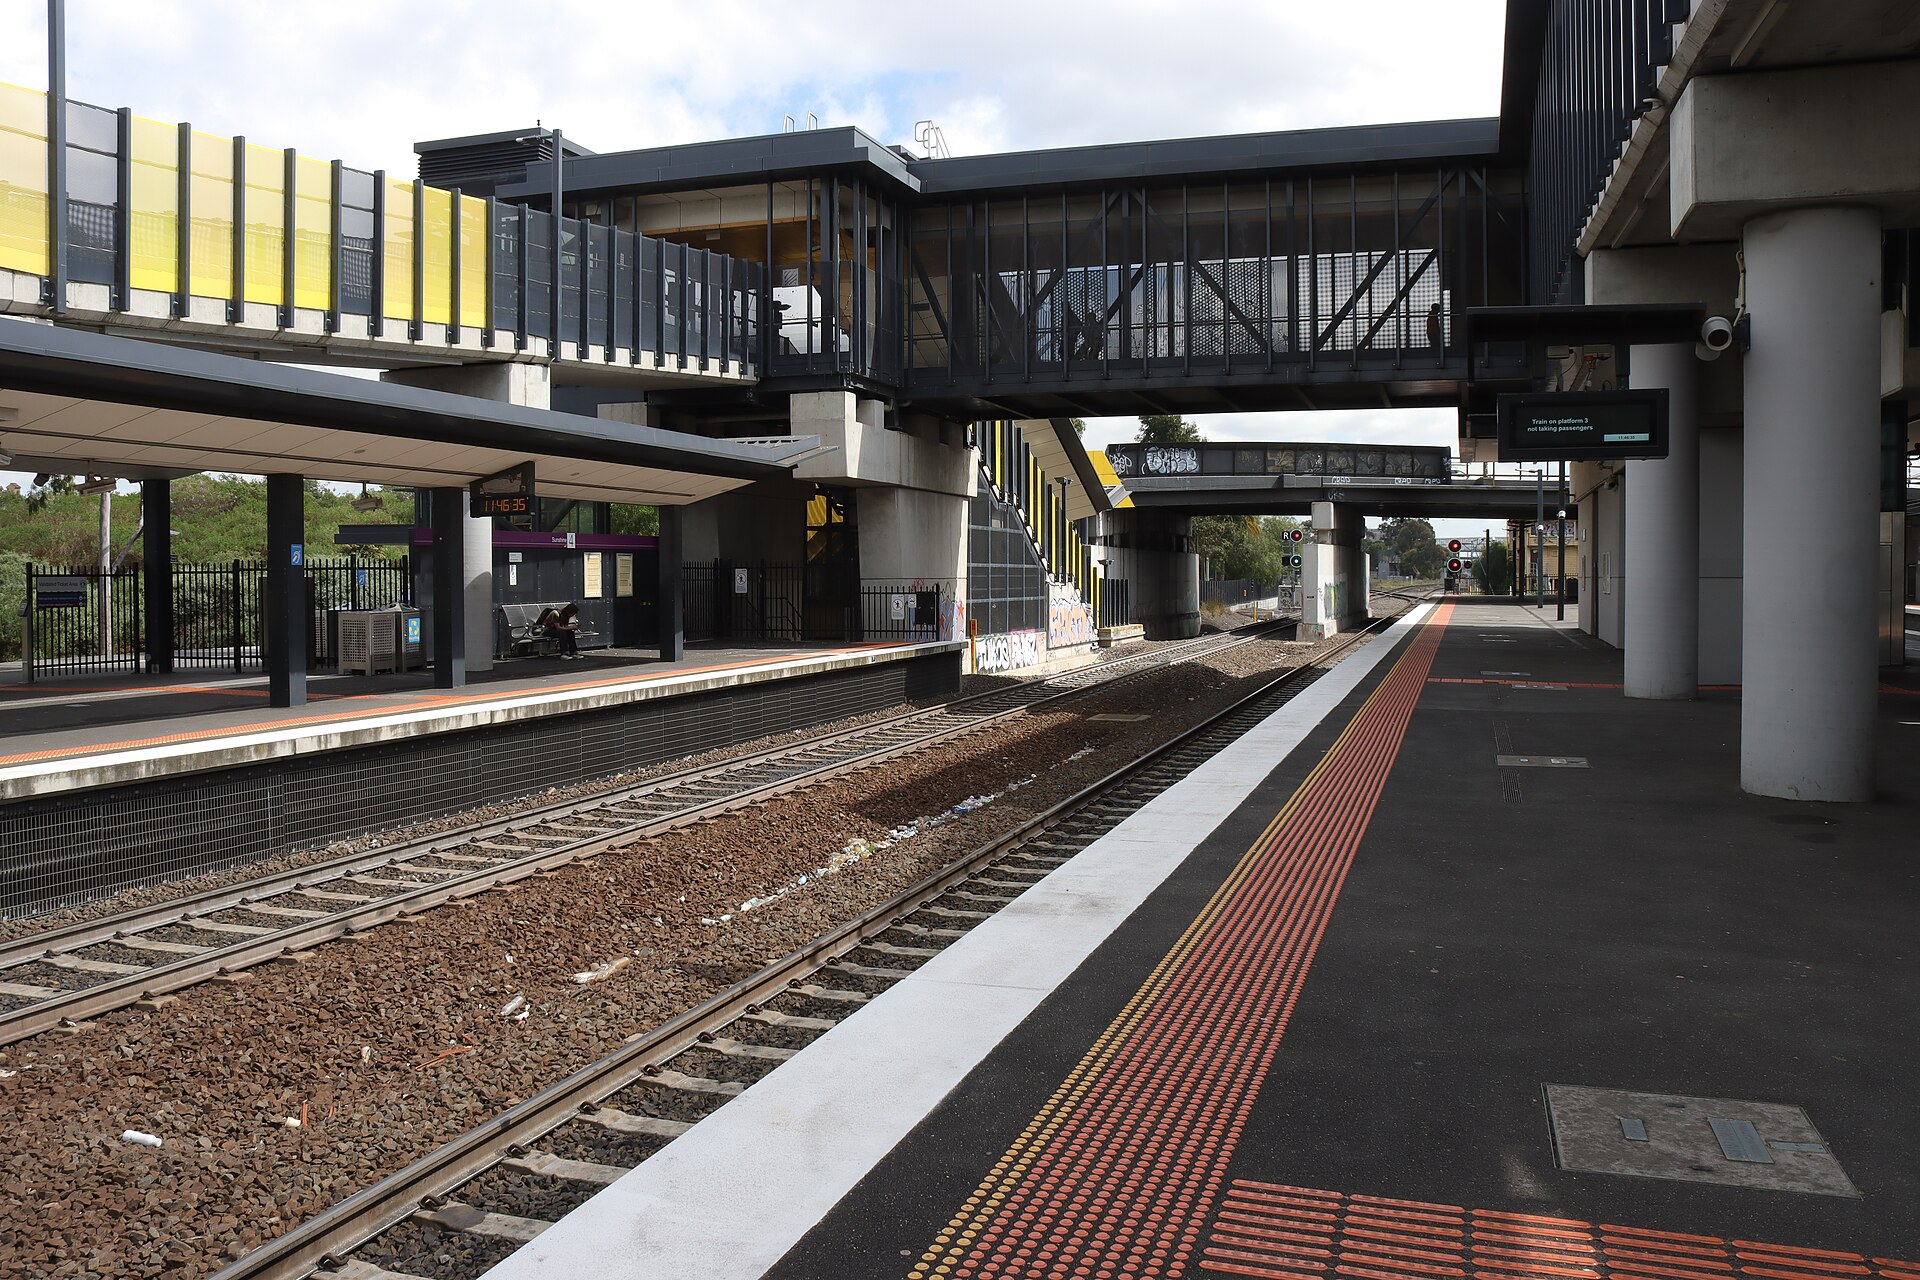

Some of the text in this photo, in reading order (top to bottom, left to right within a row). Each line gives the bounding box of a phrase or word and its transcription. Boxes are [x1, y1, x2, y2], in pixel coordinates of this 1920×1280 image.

[1558, 417, 1584, 425] platform
[1538, 425, 1558, 433] taking
[1283, 531, 1289, 540] R
